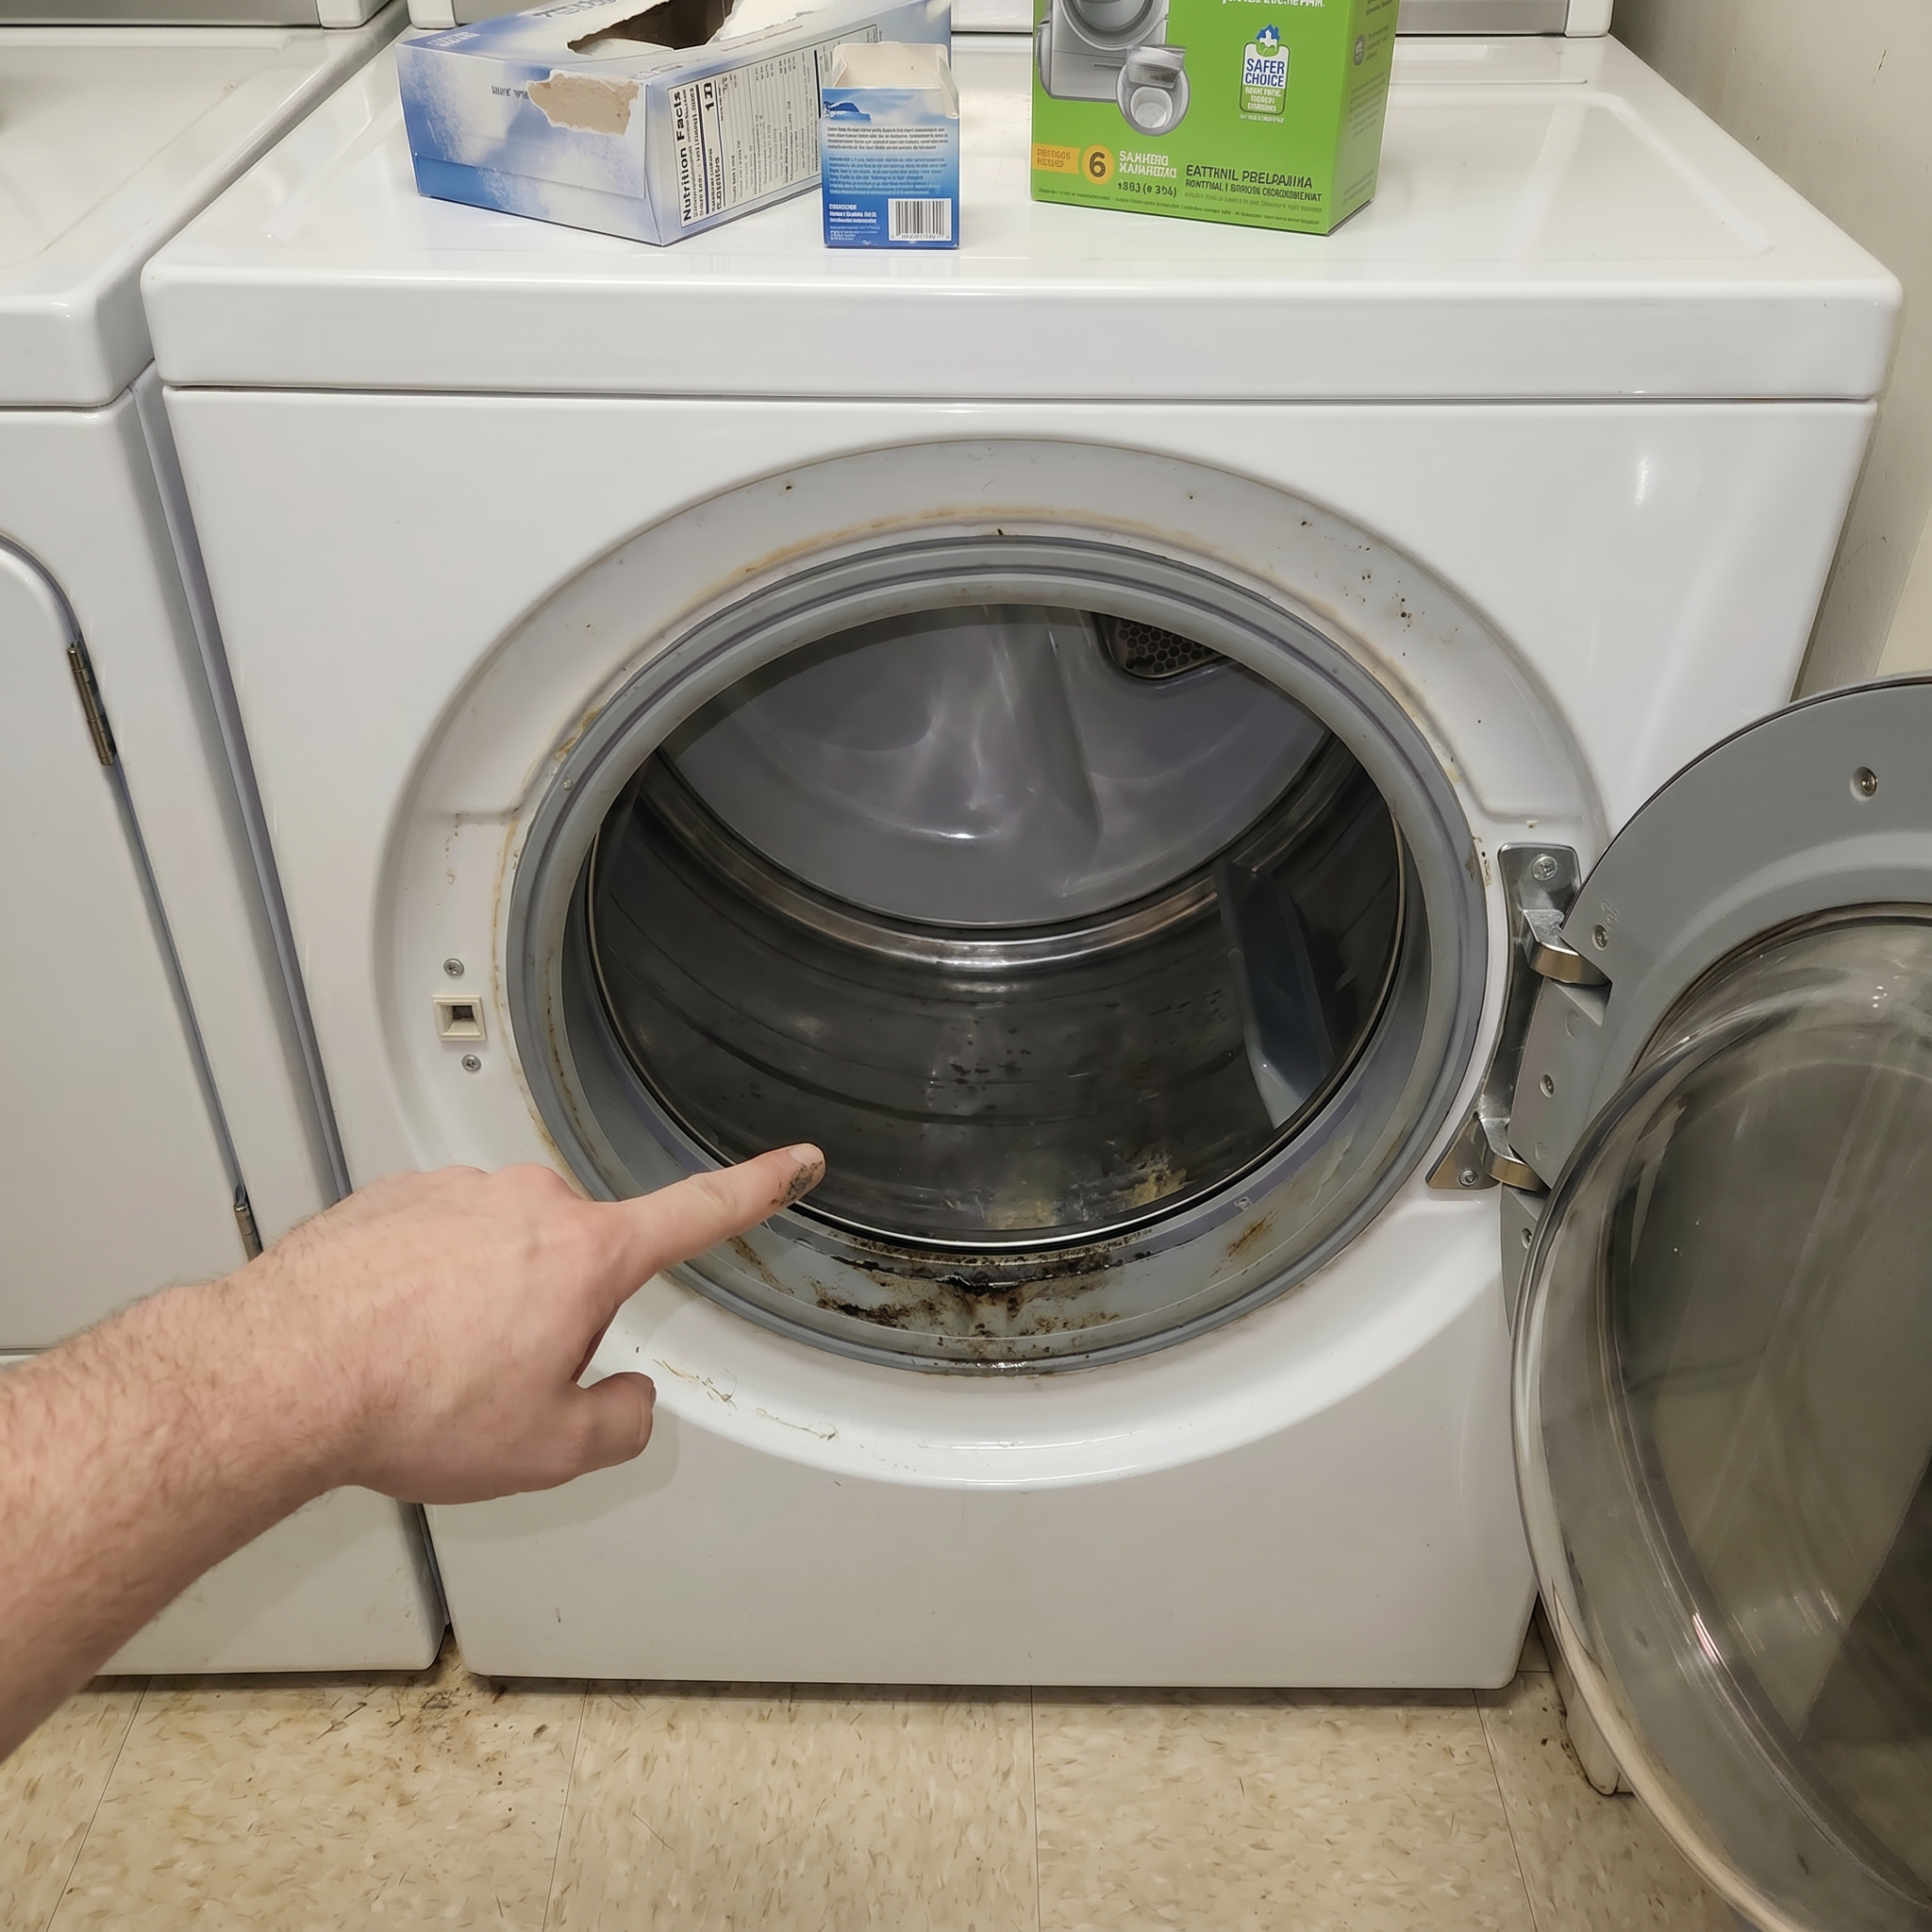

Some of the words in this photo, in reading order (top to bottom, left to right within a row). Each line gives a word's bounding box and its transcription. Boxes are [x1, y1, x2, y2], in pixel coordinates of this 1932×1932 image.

[1246, 58, 1285, 75] SAFER
[1245, 72, 1284, 87] CHOICE
[1089, 152, 1106, 178] 6
[680, 147, 692, 222] Nutrition
